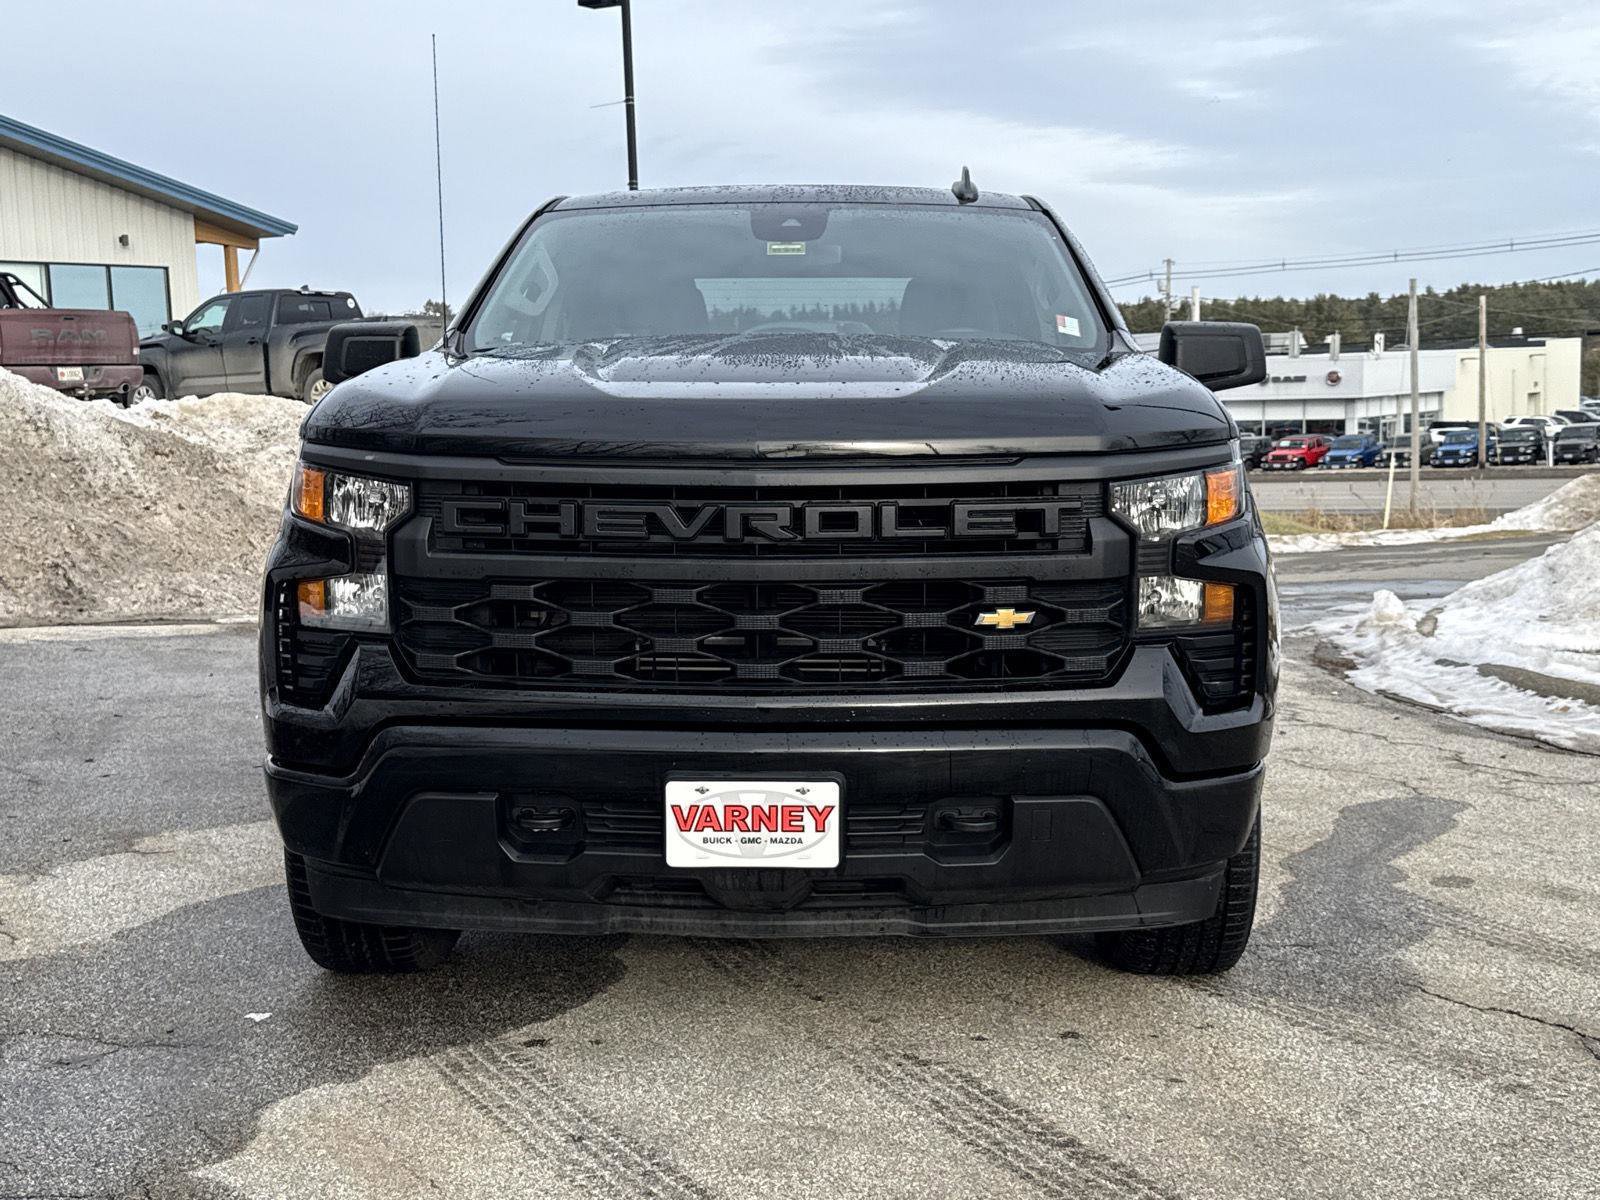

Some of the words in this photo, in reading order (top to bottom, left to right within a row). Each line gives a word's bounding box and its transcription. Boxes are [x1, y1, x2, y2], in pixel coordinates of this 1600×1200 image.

[30, 328, 107, 345] RAM
[443, 501, 1082, 540] CHEVROLET
[671, 804, 835, 833] VARNEY
[702, 837, 732, 845] BUICK
[740, 837, 762, 845] GMC
[770, 837, 804, 845] MAZDA
